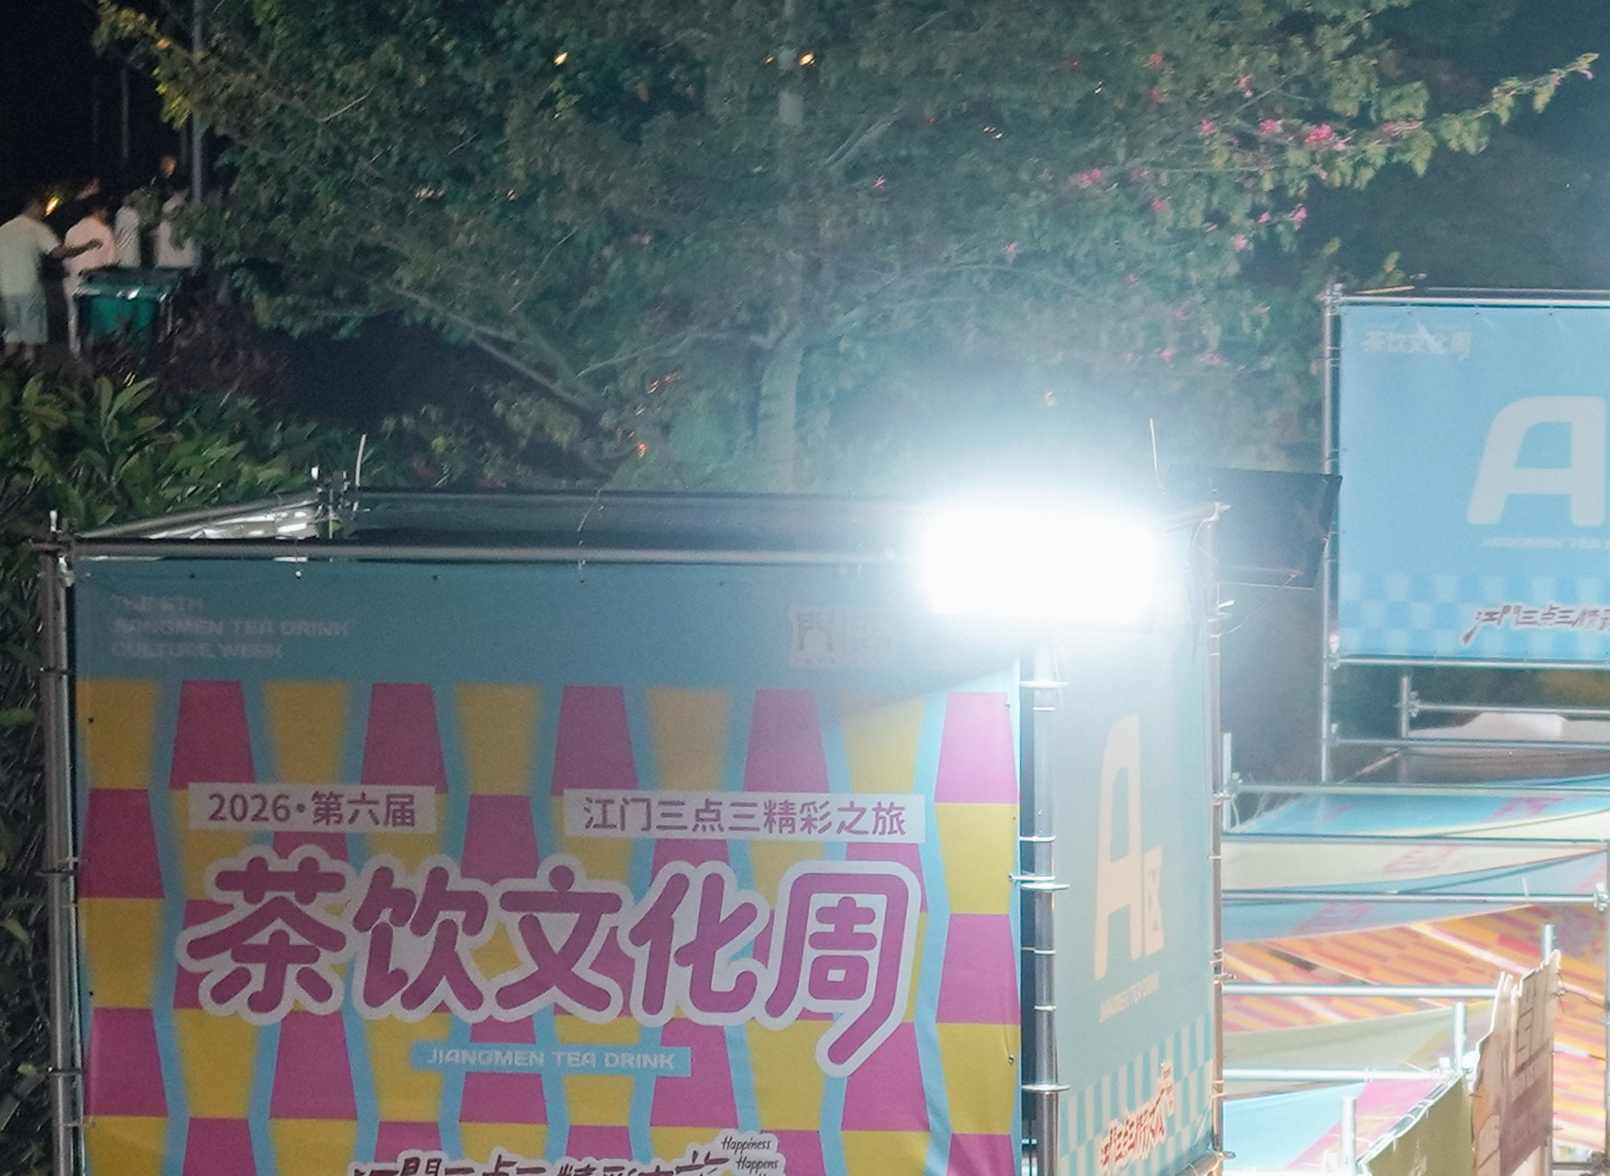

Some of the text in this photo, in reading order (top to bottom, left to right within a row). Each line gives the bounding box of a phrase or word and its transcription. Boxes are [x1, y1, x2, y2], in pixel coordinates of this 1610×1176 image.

[584, 796, 906, 836] 江门三点三精彩之旅
[186, 856, 910, 1065] 茶饮文化周
[428, 1049, 675, 1070] JIANGMEN TEA DRINK
[721, 1136, 772, 1152] Happiness
[736, 1155, 779, 1173] Happens
